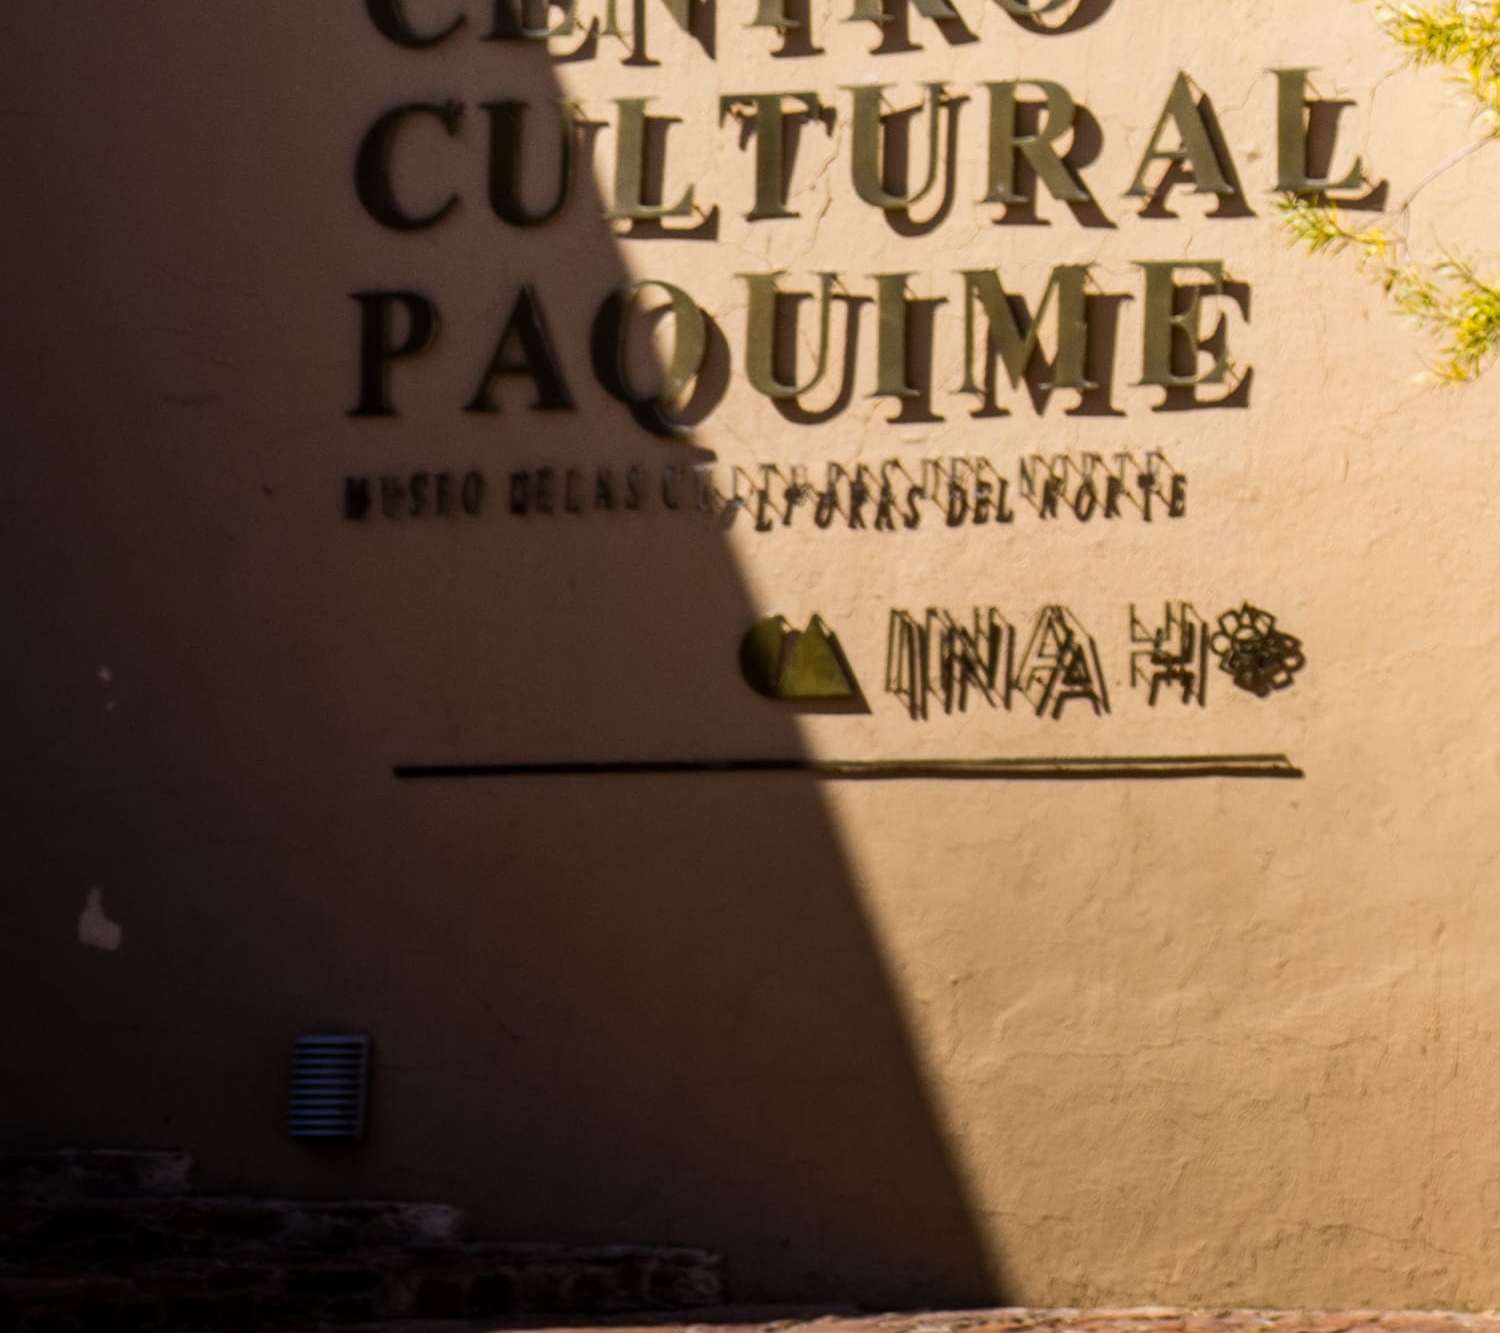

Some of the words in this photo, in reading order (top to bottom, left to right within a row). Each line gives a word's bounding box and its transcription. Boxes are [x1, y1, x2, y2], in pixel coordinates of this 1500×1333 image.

[353, 66, 1372, 235] CULTURAL
[346, 259, 1242, 439] PAQUIME
[344, 469, 488, 519] MUSEO
[1020, 451, 1187, 522] NORTE
